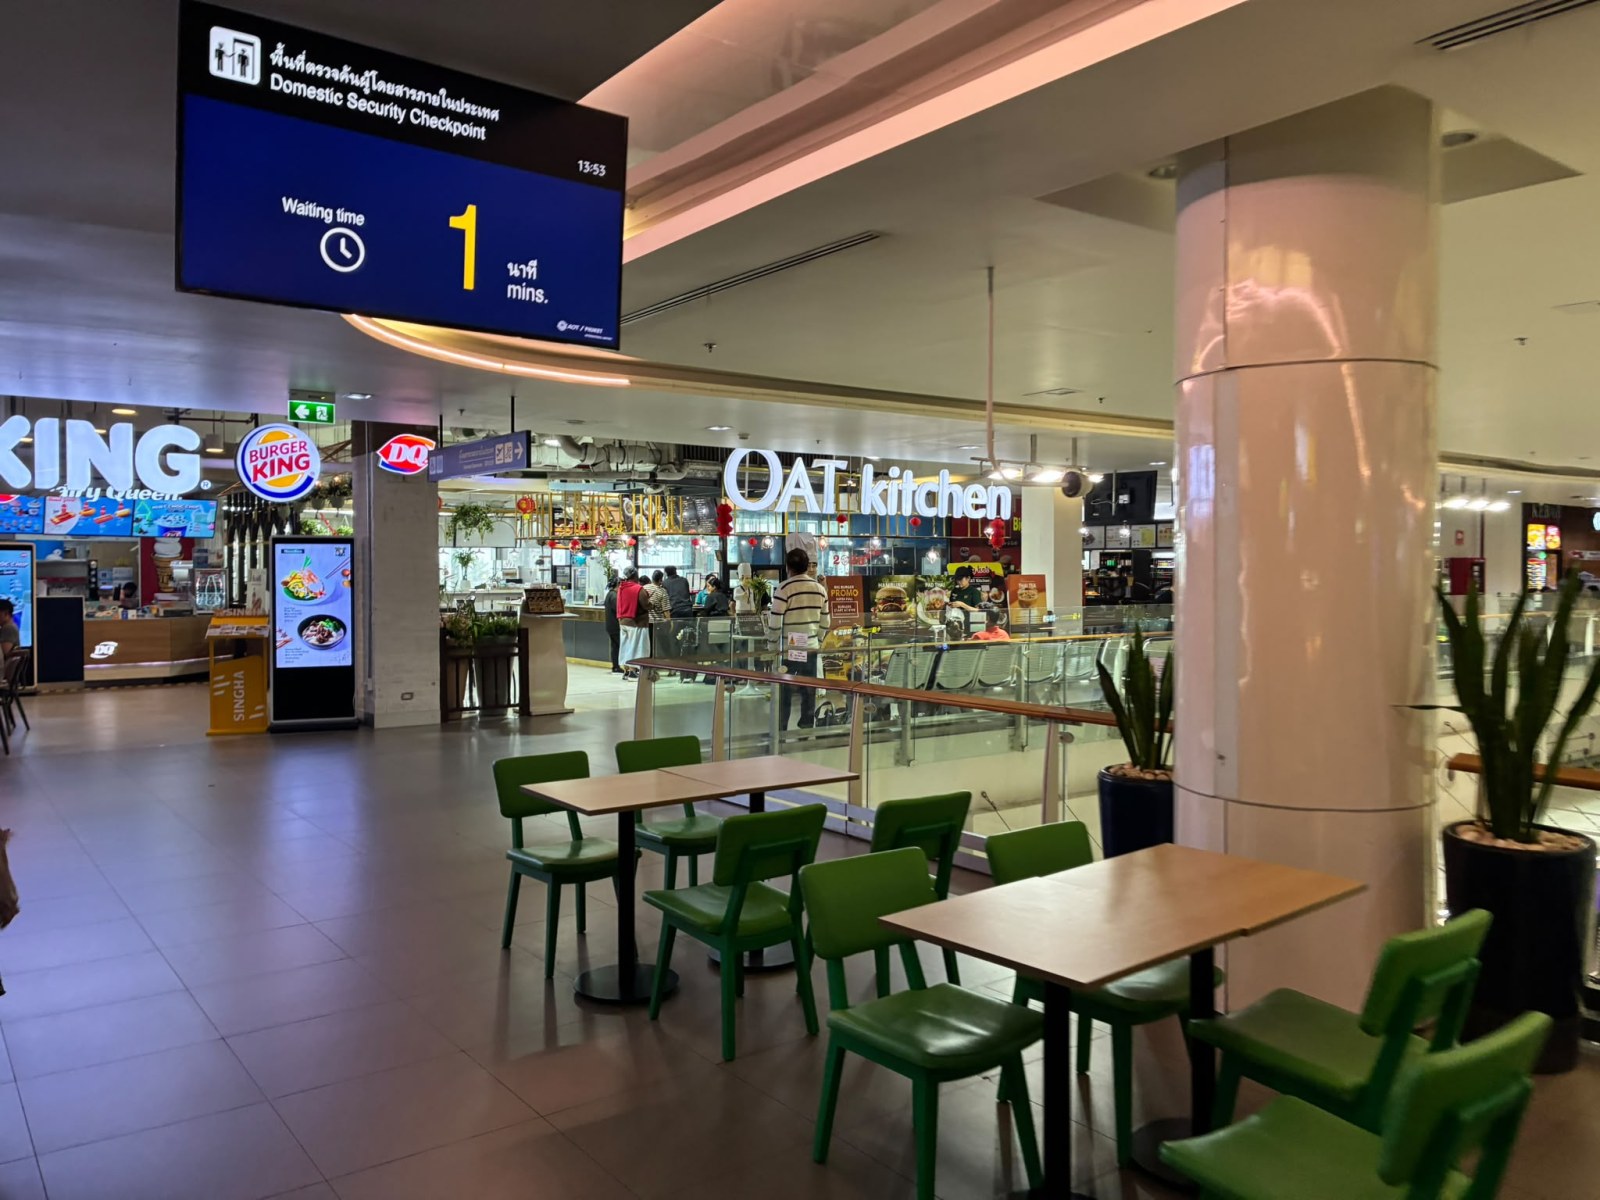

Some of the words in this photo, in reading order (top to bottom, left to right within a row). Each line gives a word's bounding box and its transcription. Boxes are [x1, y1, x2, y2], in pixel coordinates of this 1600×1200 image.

[270, 42, 500, 122] พื้นที่ตรวจค้นผู้โดยสารภายในประเทศ
[270, 72, 344, 106] Domestic
[347, 92, 406, 124] Security
[409, 107, 487, 141] Checkpoint
[577, 160, 606, 177] 13:53
[282, 196, 333, 224] Waiting
[336, 207, 365, 226] time
[449, 204, 477, 290] 1
[507, 259, 538, 280] นาที
[507, 282, 549, 304] mins.
[0, 415, 201, 495] KING
[250, 440, 307, 463] BURGER
[390, 442, 428, 467] DQ
[253, 453, 311, 483] KING
[723, 448, 848, 514] OAT
[861, 463, 1012, 520] kitchen
[830, 589, 859, 597] PROMO
[233, 670, 245, 721] SINGHA
